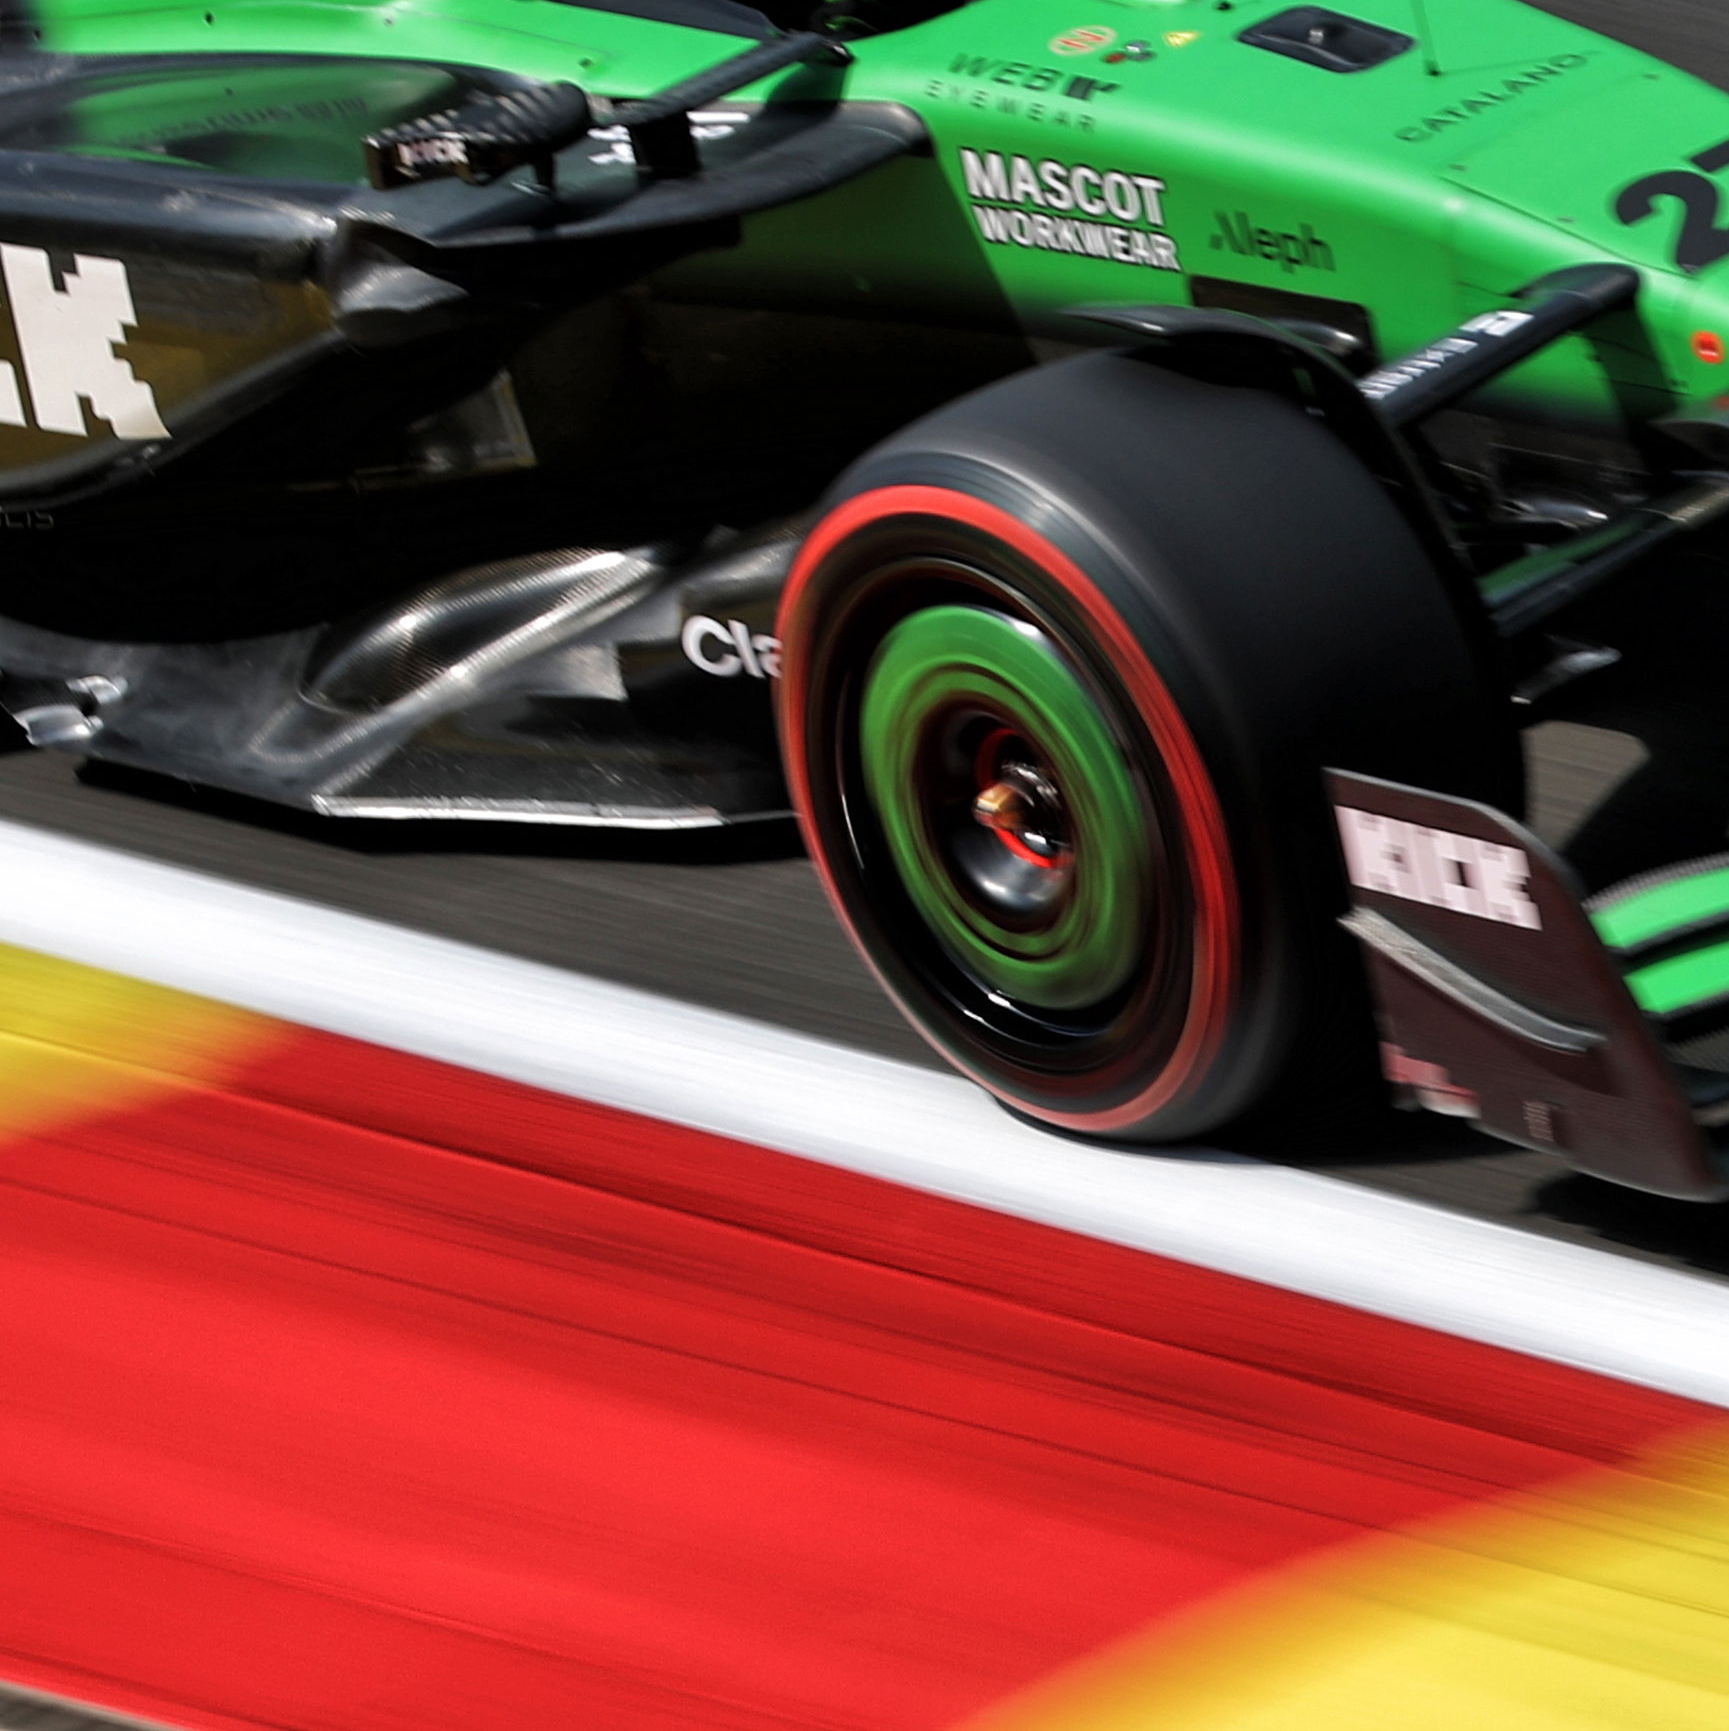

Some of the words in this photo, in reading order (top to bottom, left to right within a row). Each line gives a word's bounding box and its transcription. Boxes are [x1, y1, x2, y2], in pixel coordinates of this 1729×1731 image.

[959, 146, 1166, 227] MASCOT
[971, 203, 1184, 273] WORKWEAR
[681, 614, 781, 678] Cla
[1334, 805, 1543, 931] KICK
